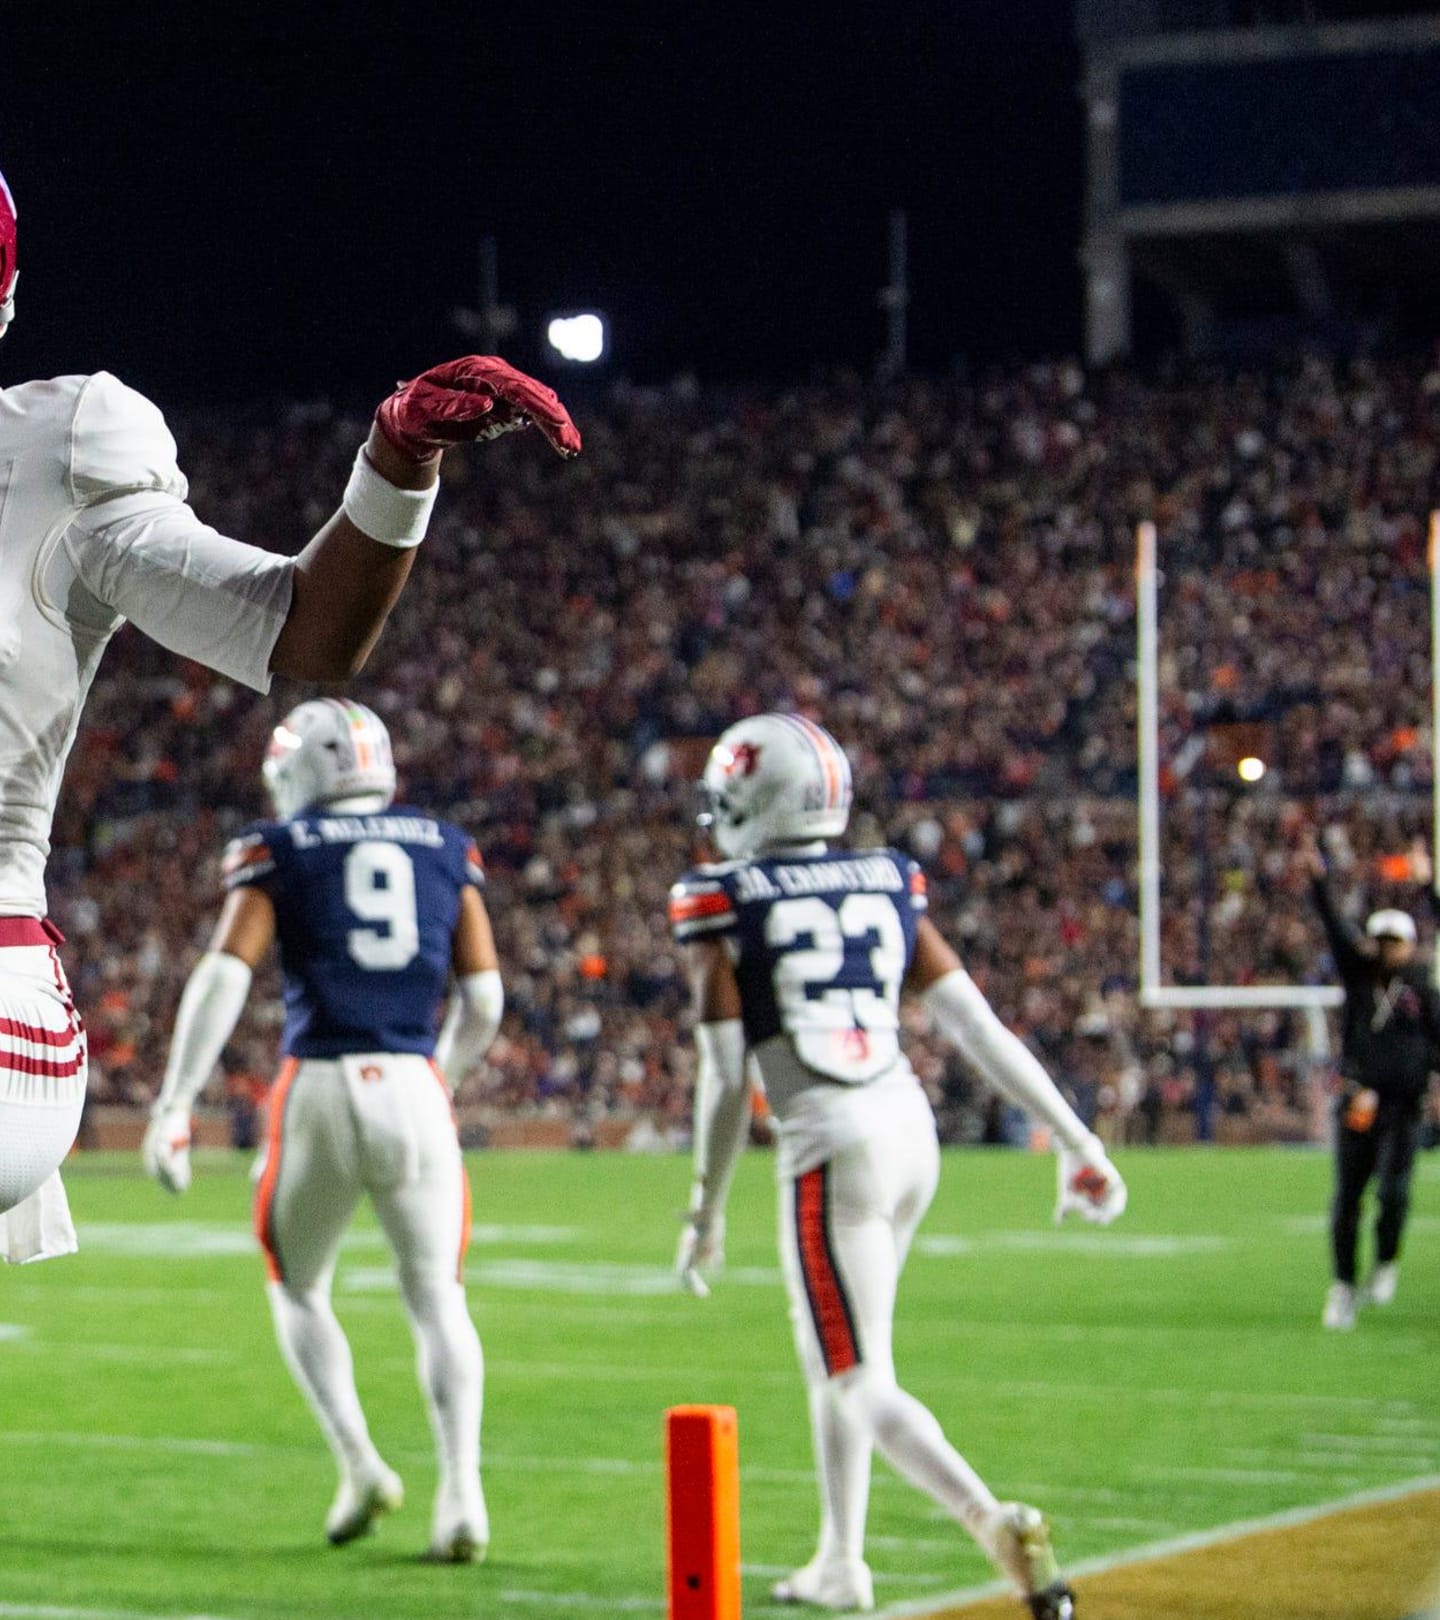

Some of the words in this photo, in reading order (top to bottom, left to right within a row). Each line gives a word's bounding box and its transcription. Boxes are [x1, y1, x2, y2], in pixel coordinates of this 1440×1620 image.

[318, 815, 445, 849] MELENDEZ
[344, 840, 420, 971] 9
[775, 856, 903, 895] CRAWFORD
[765, 893, 907, 1032] 23
